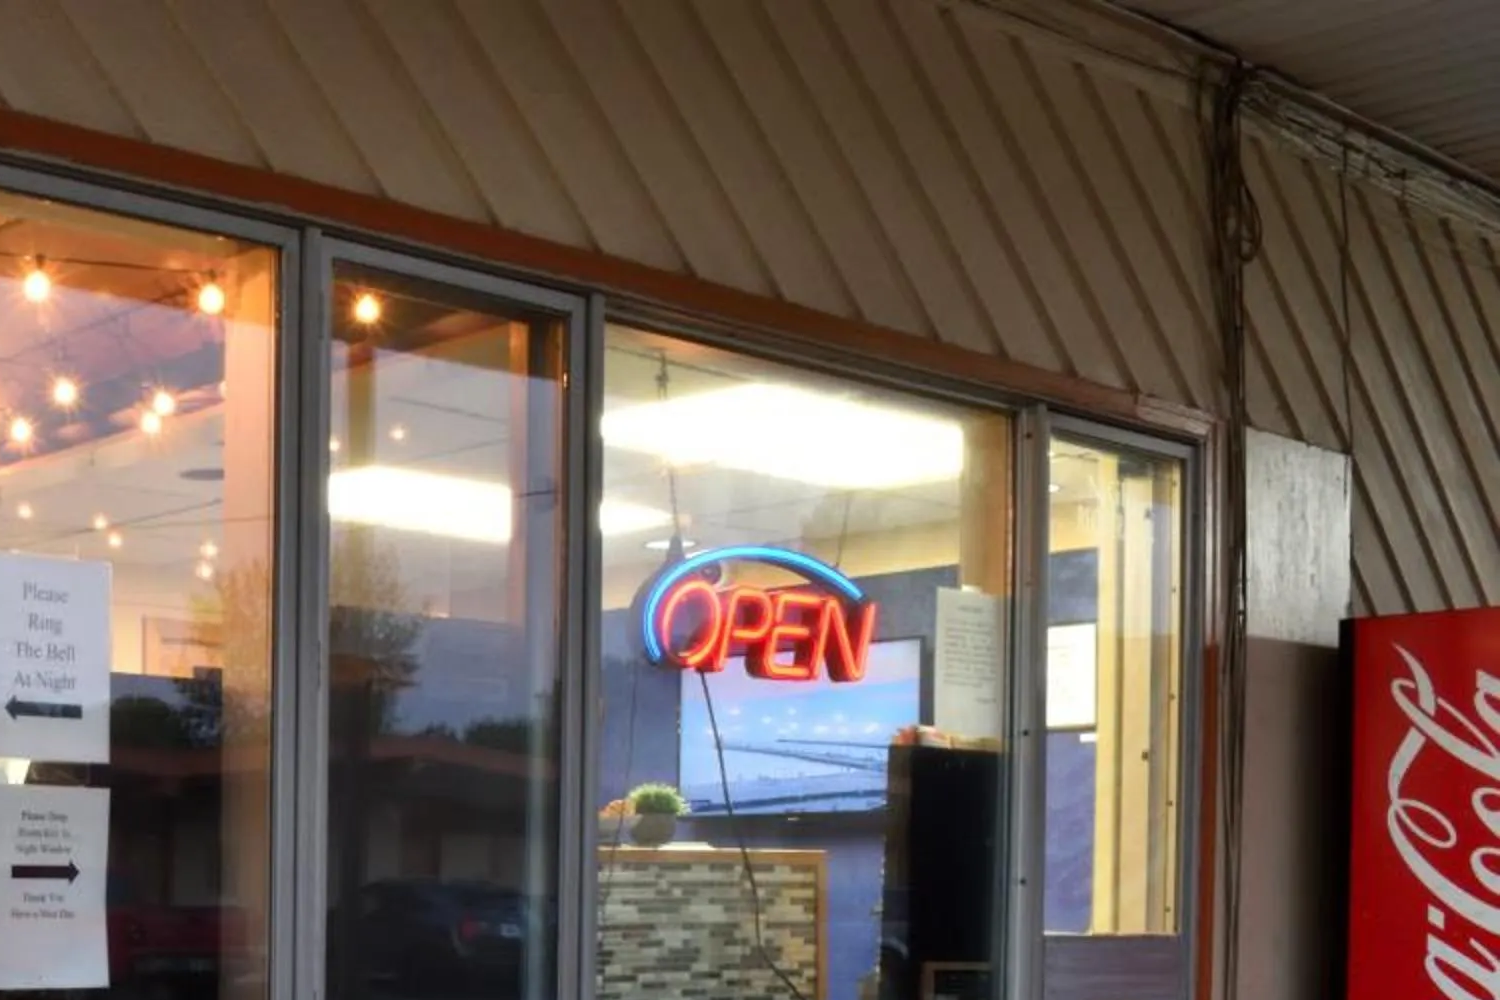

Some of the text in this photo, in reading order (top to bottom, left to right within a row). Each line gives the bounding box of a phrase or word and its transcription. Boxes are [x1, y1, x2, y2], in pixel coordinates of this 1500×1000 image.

[23, 581, 69, 604] Please
[27, 612, 62, 635] Ring
[660, 578, 878, 682] OPEN
[16, 641, 75, 662] The Bell
[14, 670, 75, 694] At Night
